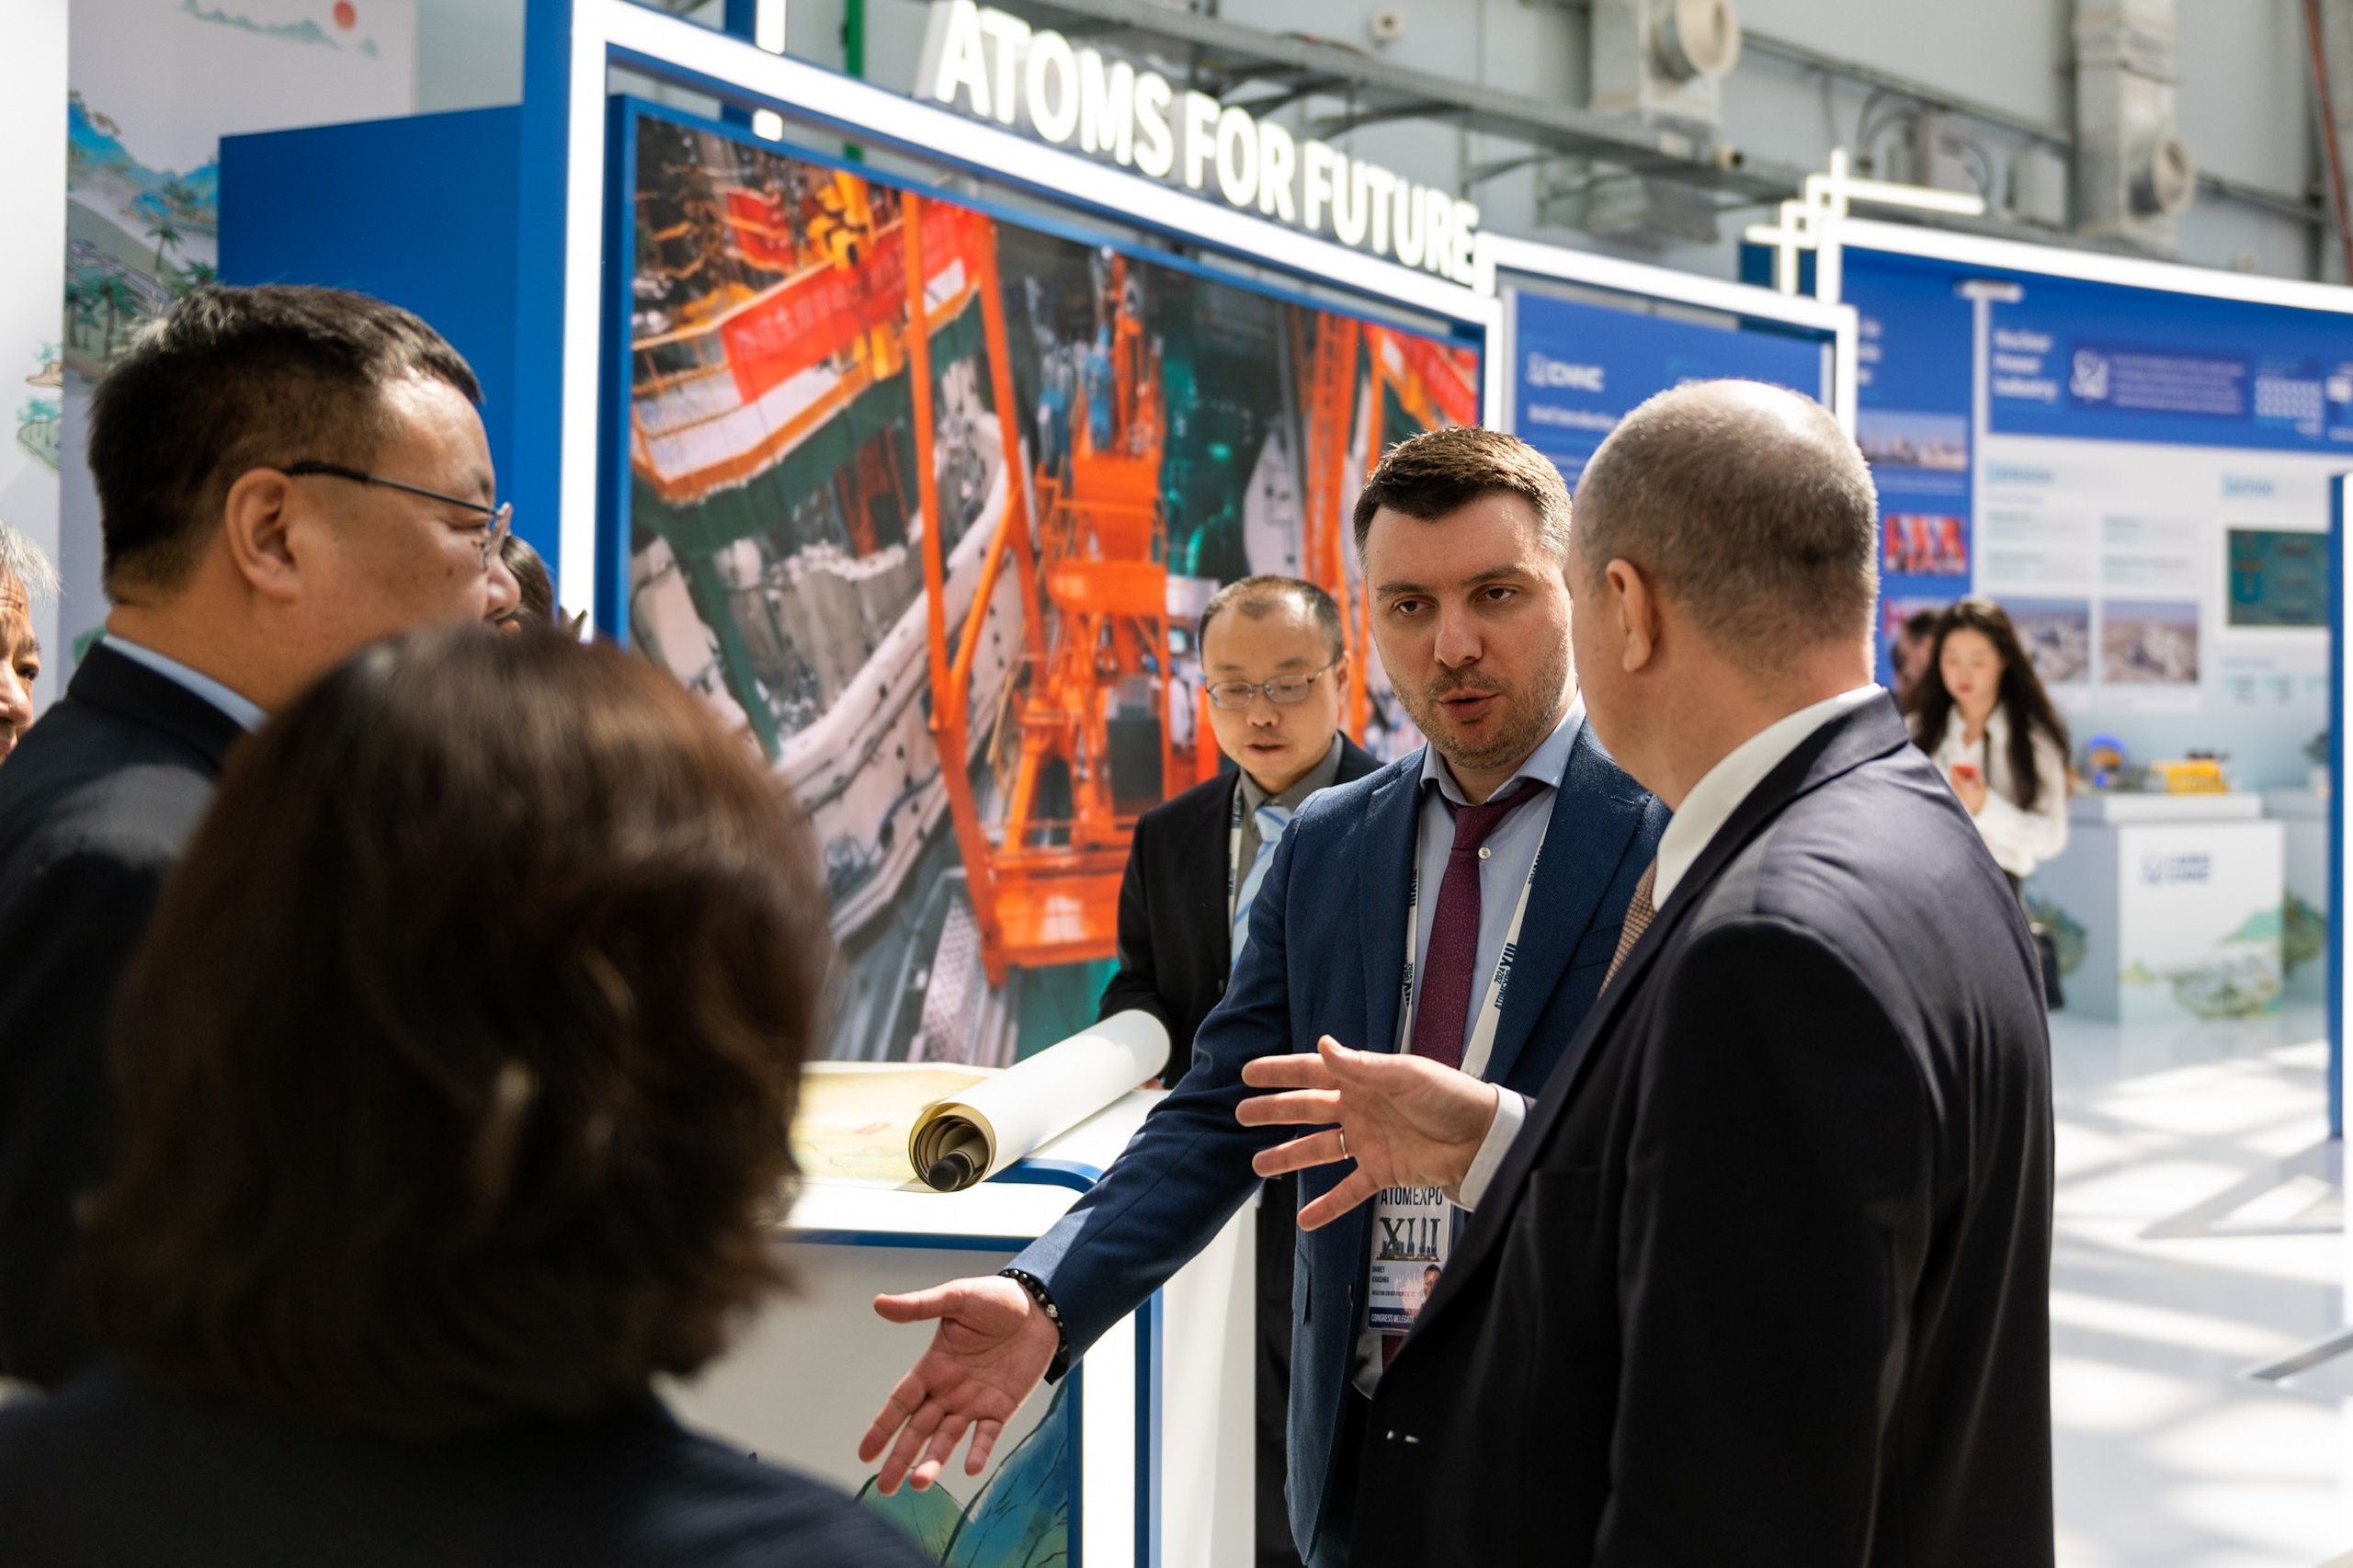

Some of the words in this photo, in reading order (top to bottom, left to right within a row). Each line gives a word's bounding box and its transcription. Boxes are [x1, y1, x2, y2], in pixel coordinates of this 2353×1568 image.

[936, 0, 1174, 177] ATOMS
[1185, 90, 1296, 223] FOR
[1304, 139, 1481, 287] FUTURE
[1494, 967, 1506, 984] 2024
[1380, 1186, 1443, 1206] ATOMEXPO
[1370, 1312, 1393, 1323] CONGRESS
